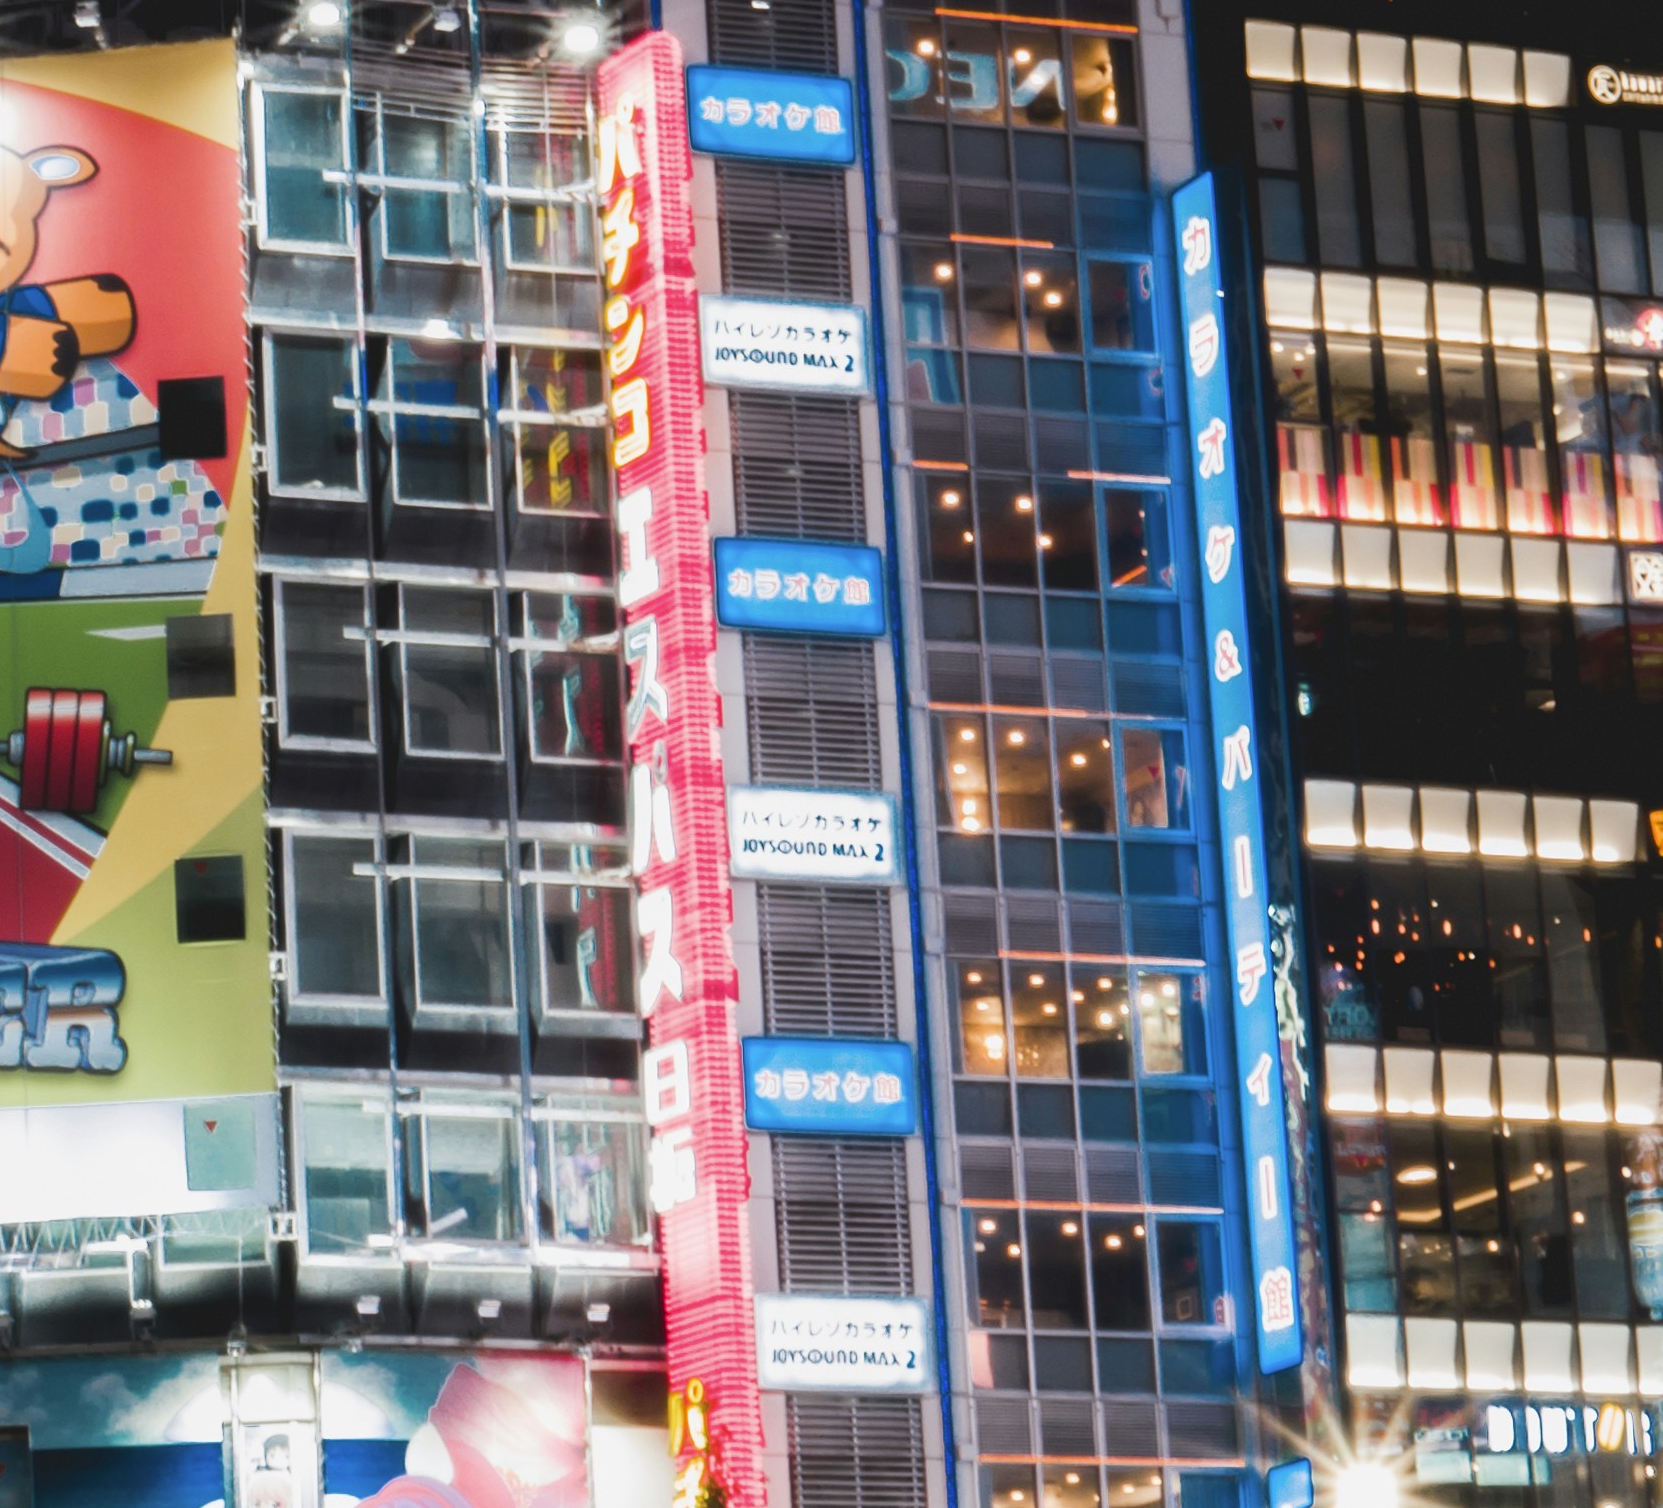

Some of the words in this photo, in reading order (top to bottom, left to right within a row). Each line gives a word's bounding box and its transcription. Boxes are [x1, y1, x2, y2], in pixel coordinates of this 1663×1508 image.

[698, 96, 843, 136] カラオケ館
[714, 346, 798, 367] JOYSOUND
[726, 568, 873, 605] カラオケ館
[1180, 215, 1295, 1334] カラオケ&パーティー館
[741, 838, 827, 857] JOYSOUND
[754, 1067, 904, 1105] カラオケ館
[772, 1348, 859, 1365] JOYSOUND
